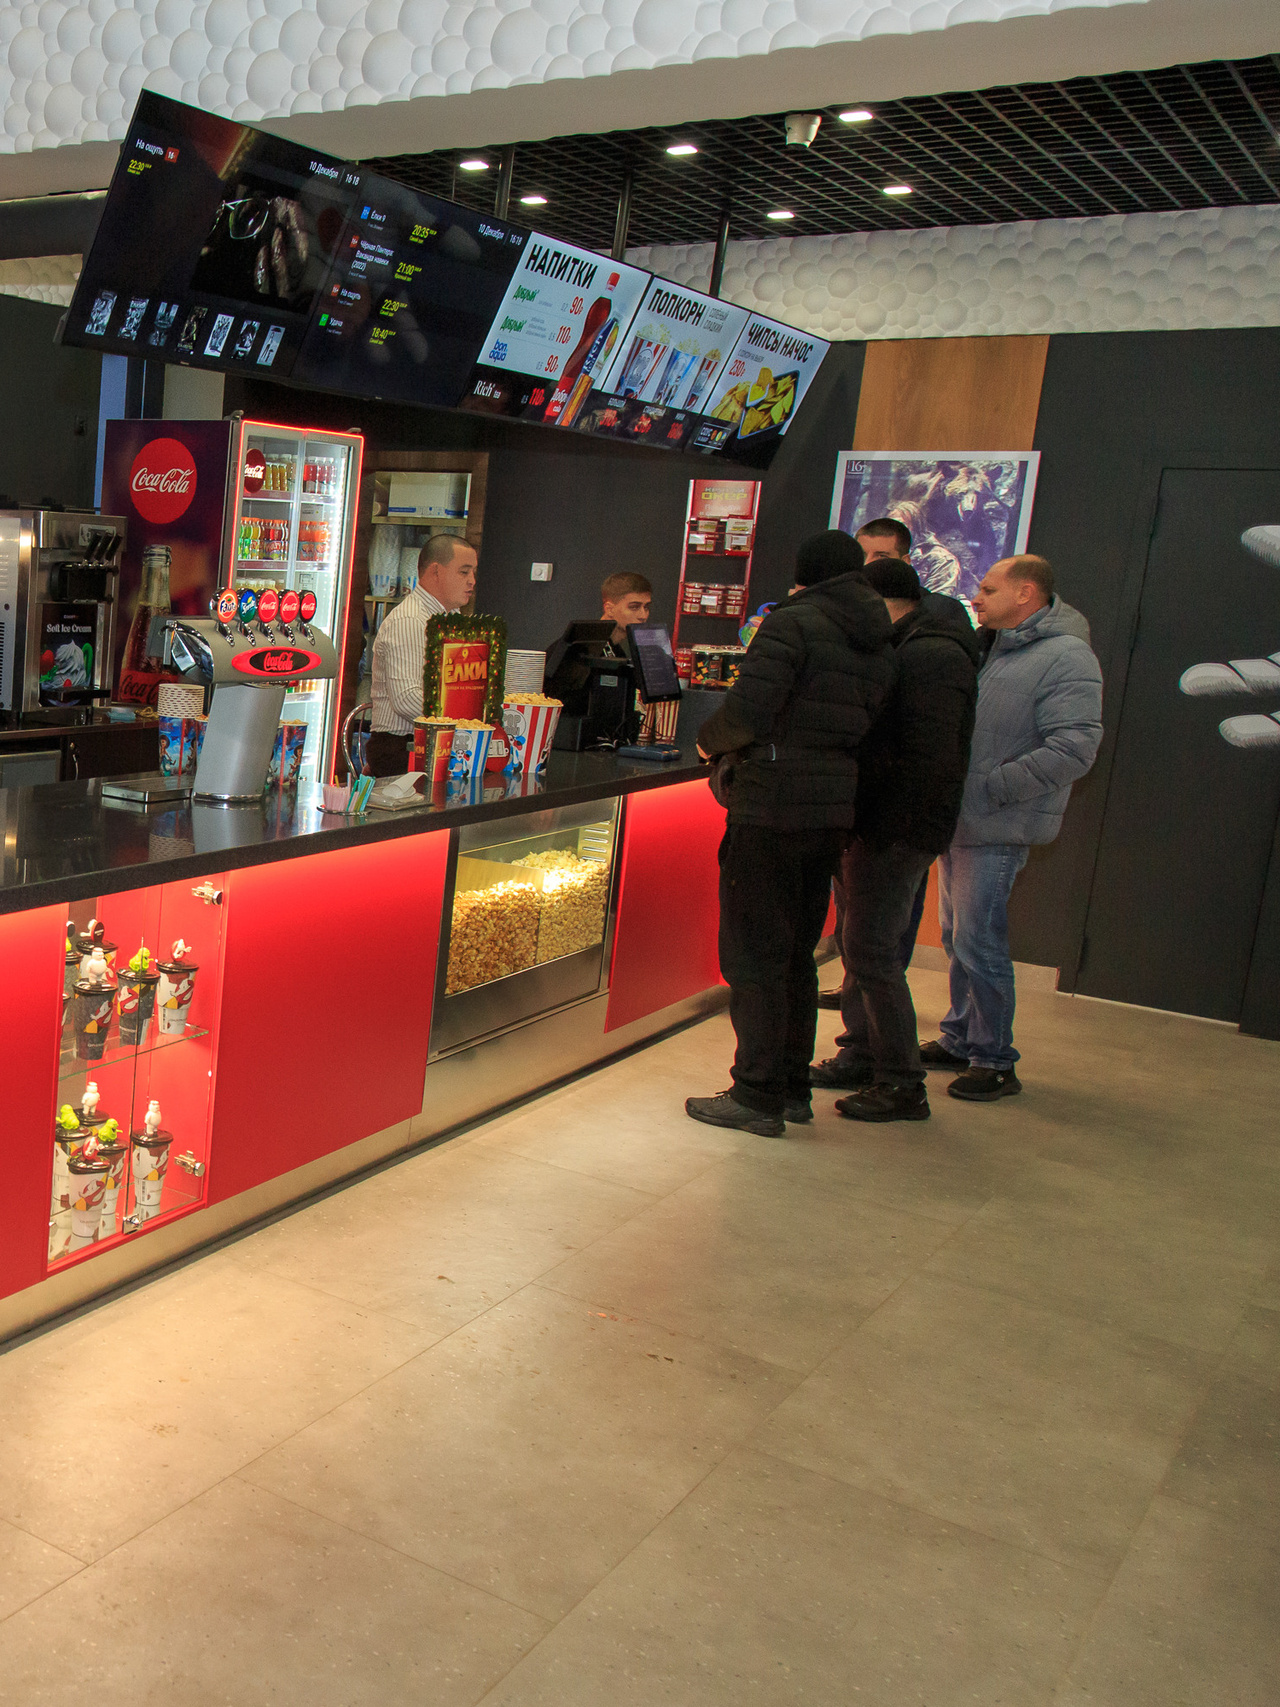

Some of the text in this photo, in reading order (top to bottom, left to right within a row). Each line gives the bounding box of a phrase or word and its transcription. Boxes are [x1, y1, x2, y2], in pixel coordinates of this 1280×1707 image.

[135, 138, 145, 149] На
[129, 159, 144, 172] 22:30
[309, 161, 339, 180] 10 Декабря
[412, 224, 430, 239] 20:35
[397, 262, 414, 275] 21:00
[525, 243, 598, 290] НАПИТКИ
[382, 299, 400, 312] 22:30
[647, 287, 707, 326] ПОПКОРН
[372, 327, 388, 339] 18:40
[748, 322, 814, 363] ЧИПСЫ НАЧОС
[488, 350, 507, 362] aqua
[473, 380, 493, 397] Rich
[132, 467, 194, 494] Coca-Cola
[219, 600, 237, 613] Fanta
[46, 623, 92, 633] Soft Ice Cream
[263, 652, 294, 671] Coca-Cola
[462, 648, 469, 661] 9
[444, 657, 488, 684] ЁЛКИ
